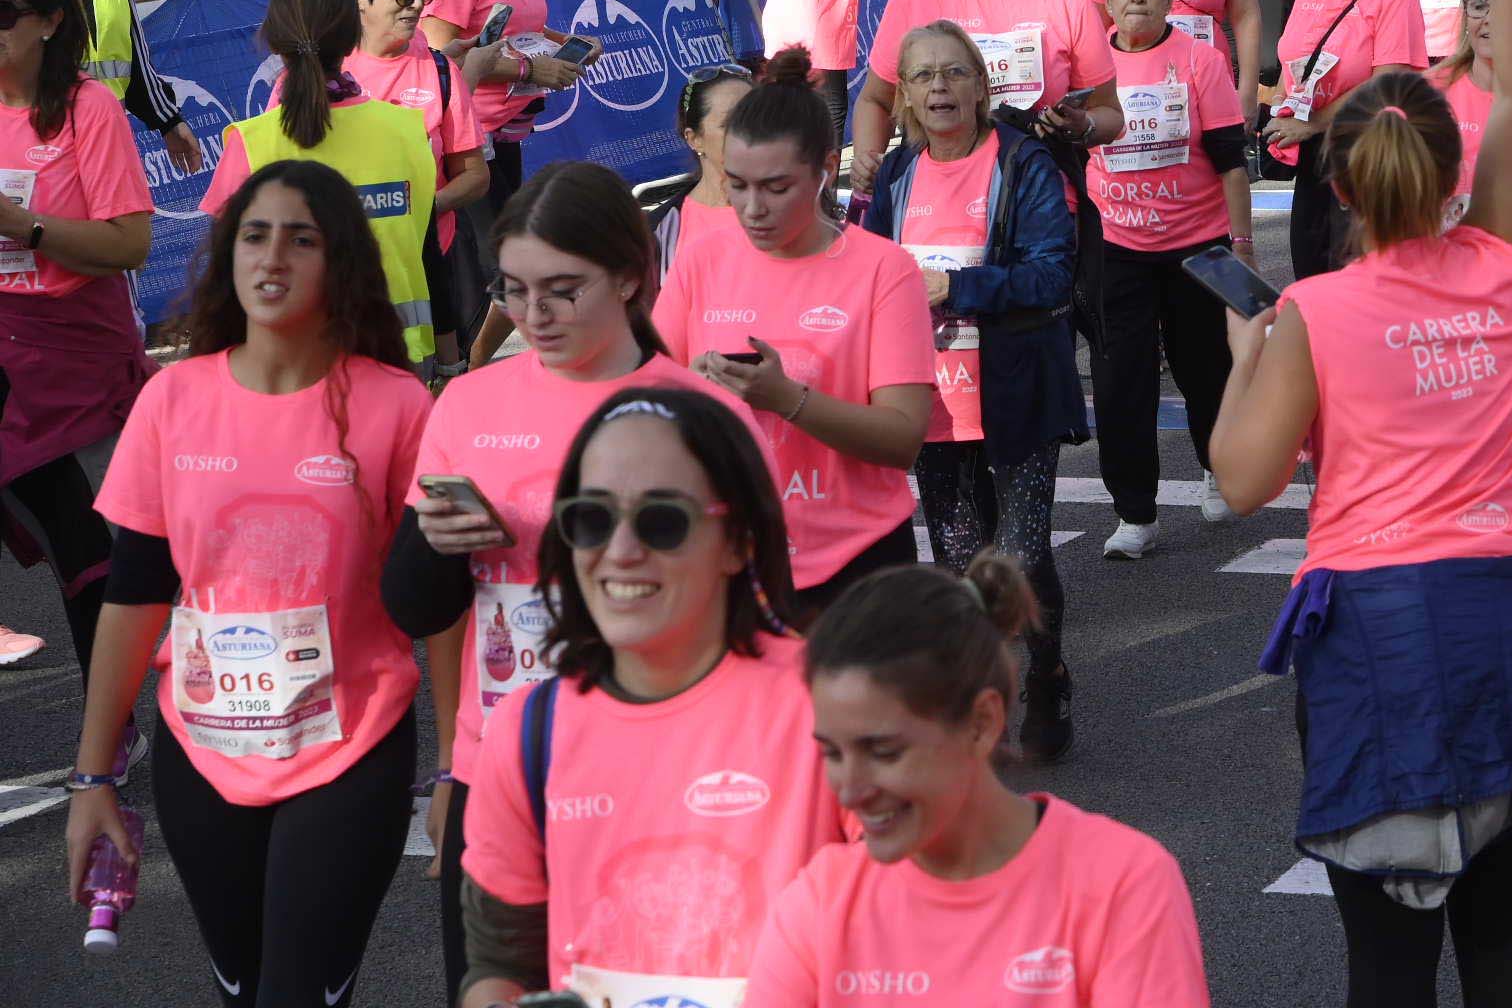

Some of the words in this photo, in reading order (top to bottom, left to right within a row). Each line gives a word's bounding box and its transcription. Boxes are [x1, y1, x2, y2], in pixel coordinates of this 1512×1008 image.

[1128, 118, 1158, 131] 016
[703, 308, 756, 324] OYSHO
[1385, 305, 1505, 350] CARRERA
[1412, 341, 1445, 370] DE
[1456, 335, 1489, 359] LA
[1415, 354, 1500, 397] MUJER
[473, 433, 541, 450] OYSHO
[174, 454, 238, 473] OYSHO
[283, 628, 316, 640] SUMA
[212, 640, 272, 653] ASTURIANA
[219, 672, 275, 693] 016
[228, 700, 271, 713] 31908
[193, 716, 232, 728] CARRERA
[234, 718, 247, 728] DE
[249, 718, 261, 727] LA
[835, 969, 931, 995] OYSHO
